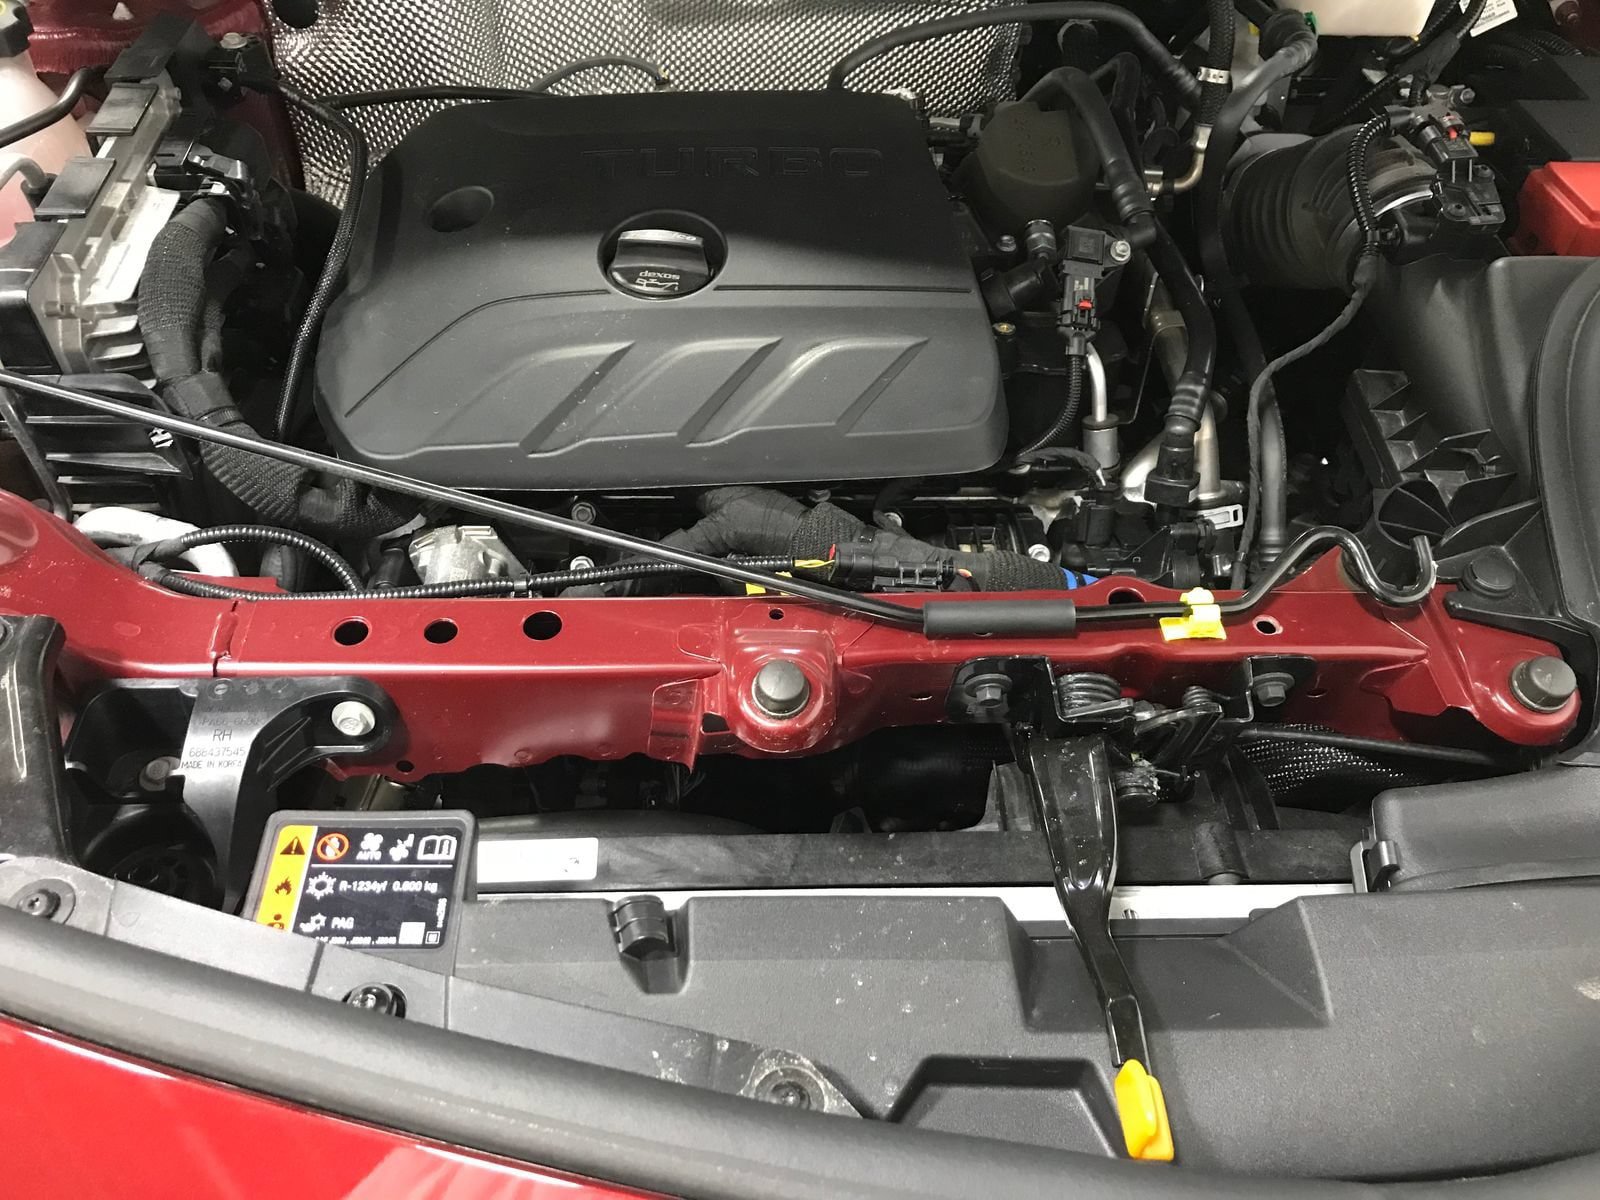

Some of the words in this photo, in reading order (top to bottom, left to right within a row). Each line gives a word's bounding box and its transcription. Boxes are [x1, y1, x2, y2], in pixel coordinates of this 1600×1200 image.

[581, 146, 884, 177] TURBO
[638, 270, 680, 280] dexos
[212, 728, 233, 741] RH
[181, 760, 203, 769] MADE
[206, 760, 215, 768] IN
[423, 881, 438, 893] kg
[331, 916, 355, 930] PAG
